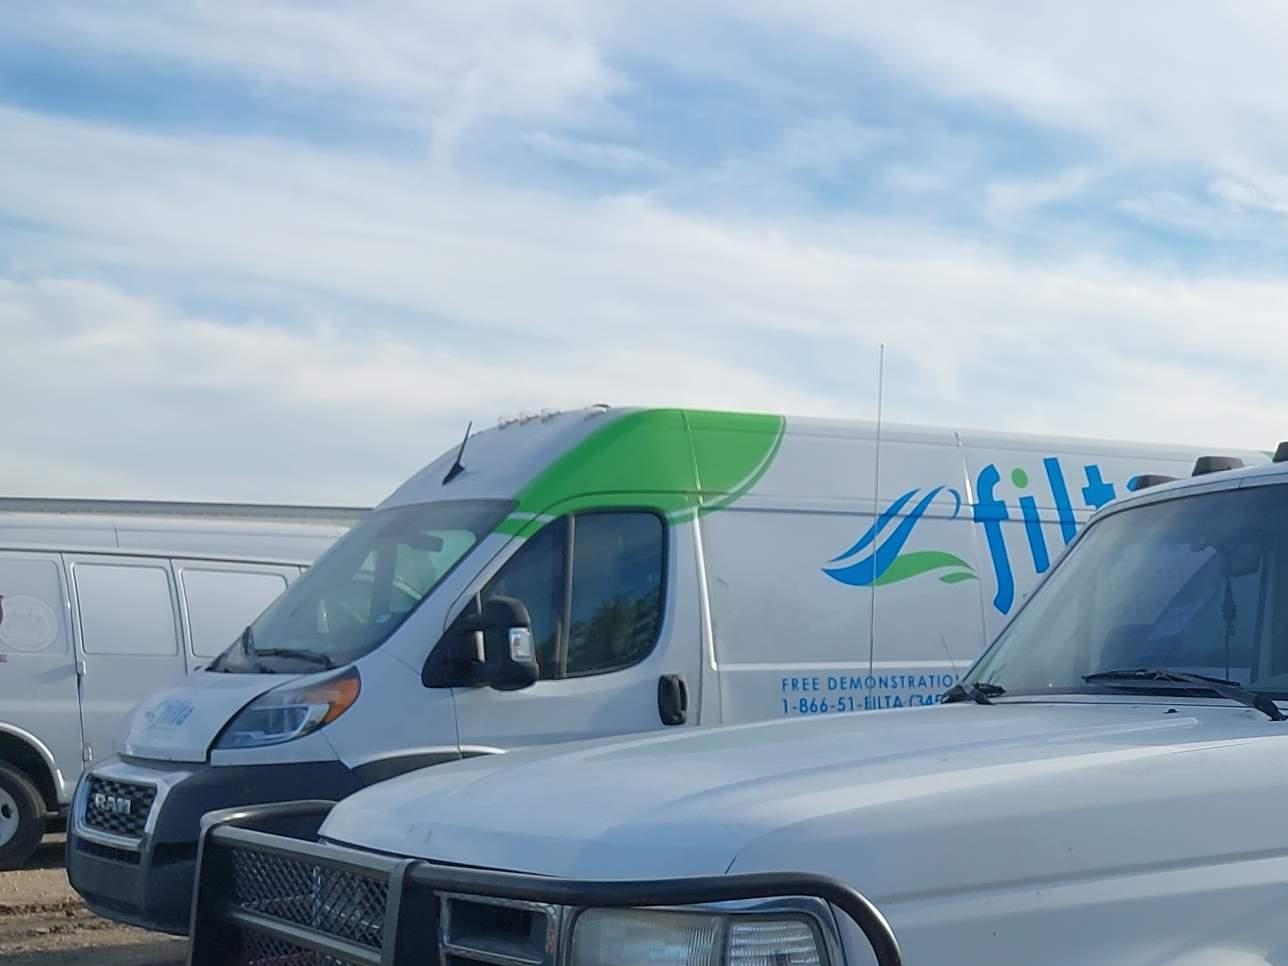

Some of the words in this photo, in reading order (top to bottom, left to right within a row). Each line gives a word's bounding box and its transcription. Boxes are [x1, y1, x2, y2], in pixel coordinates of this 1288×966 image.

[782, 677, 820, 692] FREE
[827, 674, 960, 691] DEMONSTRATIO
[95, 793, 131, 814] RAM
